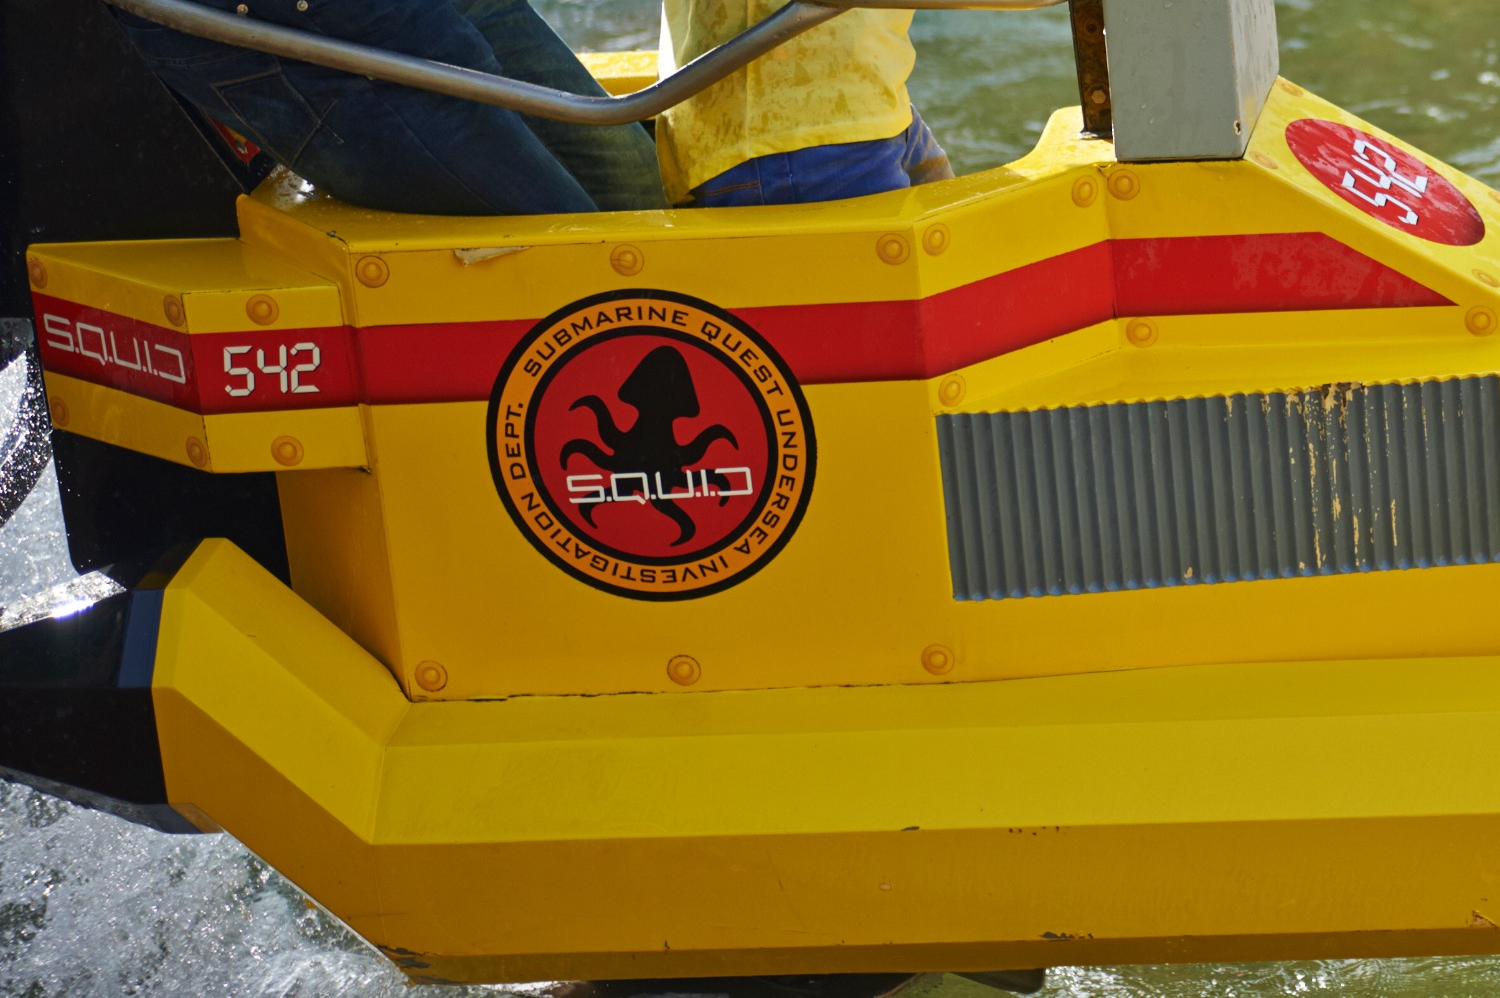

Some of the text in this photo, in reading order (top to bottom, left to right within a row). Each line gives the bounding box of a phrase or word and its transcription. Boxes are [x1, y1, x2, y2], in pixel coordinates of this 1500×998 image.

[1340, 138, 1429, 226] 542
[223, 342, 321, 397] 542
[504, 305, 799, 584] SUBMARINE QUEST UNDERSEA INVESTIGATION DEPT.
